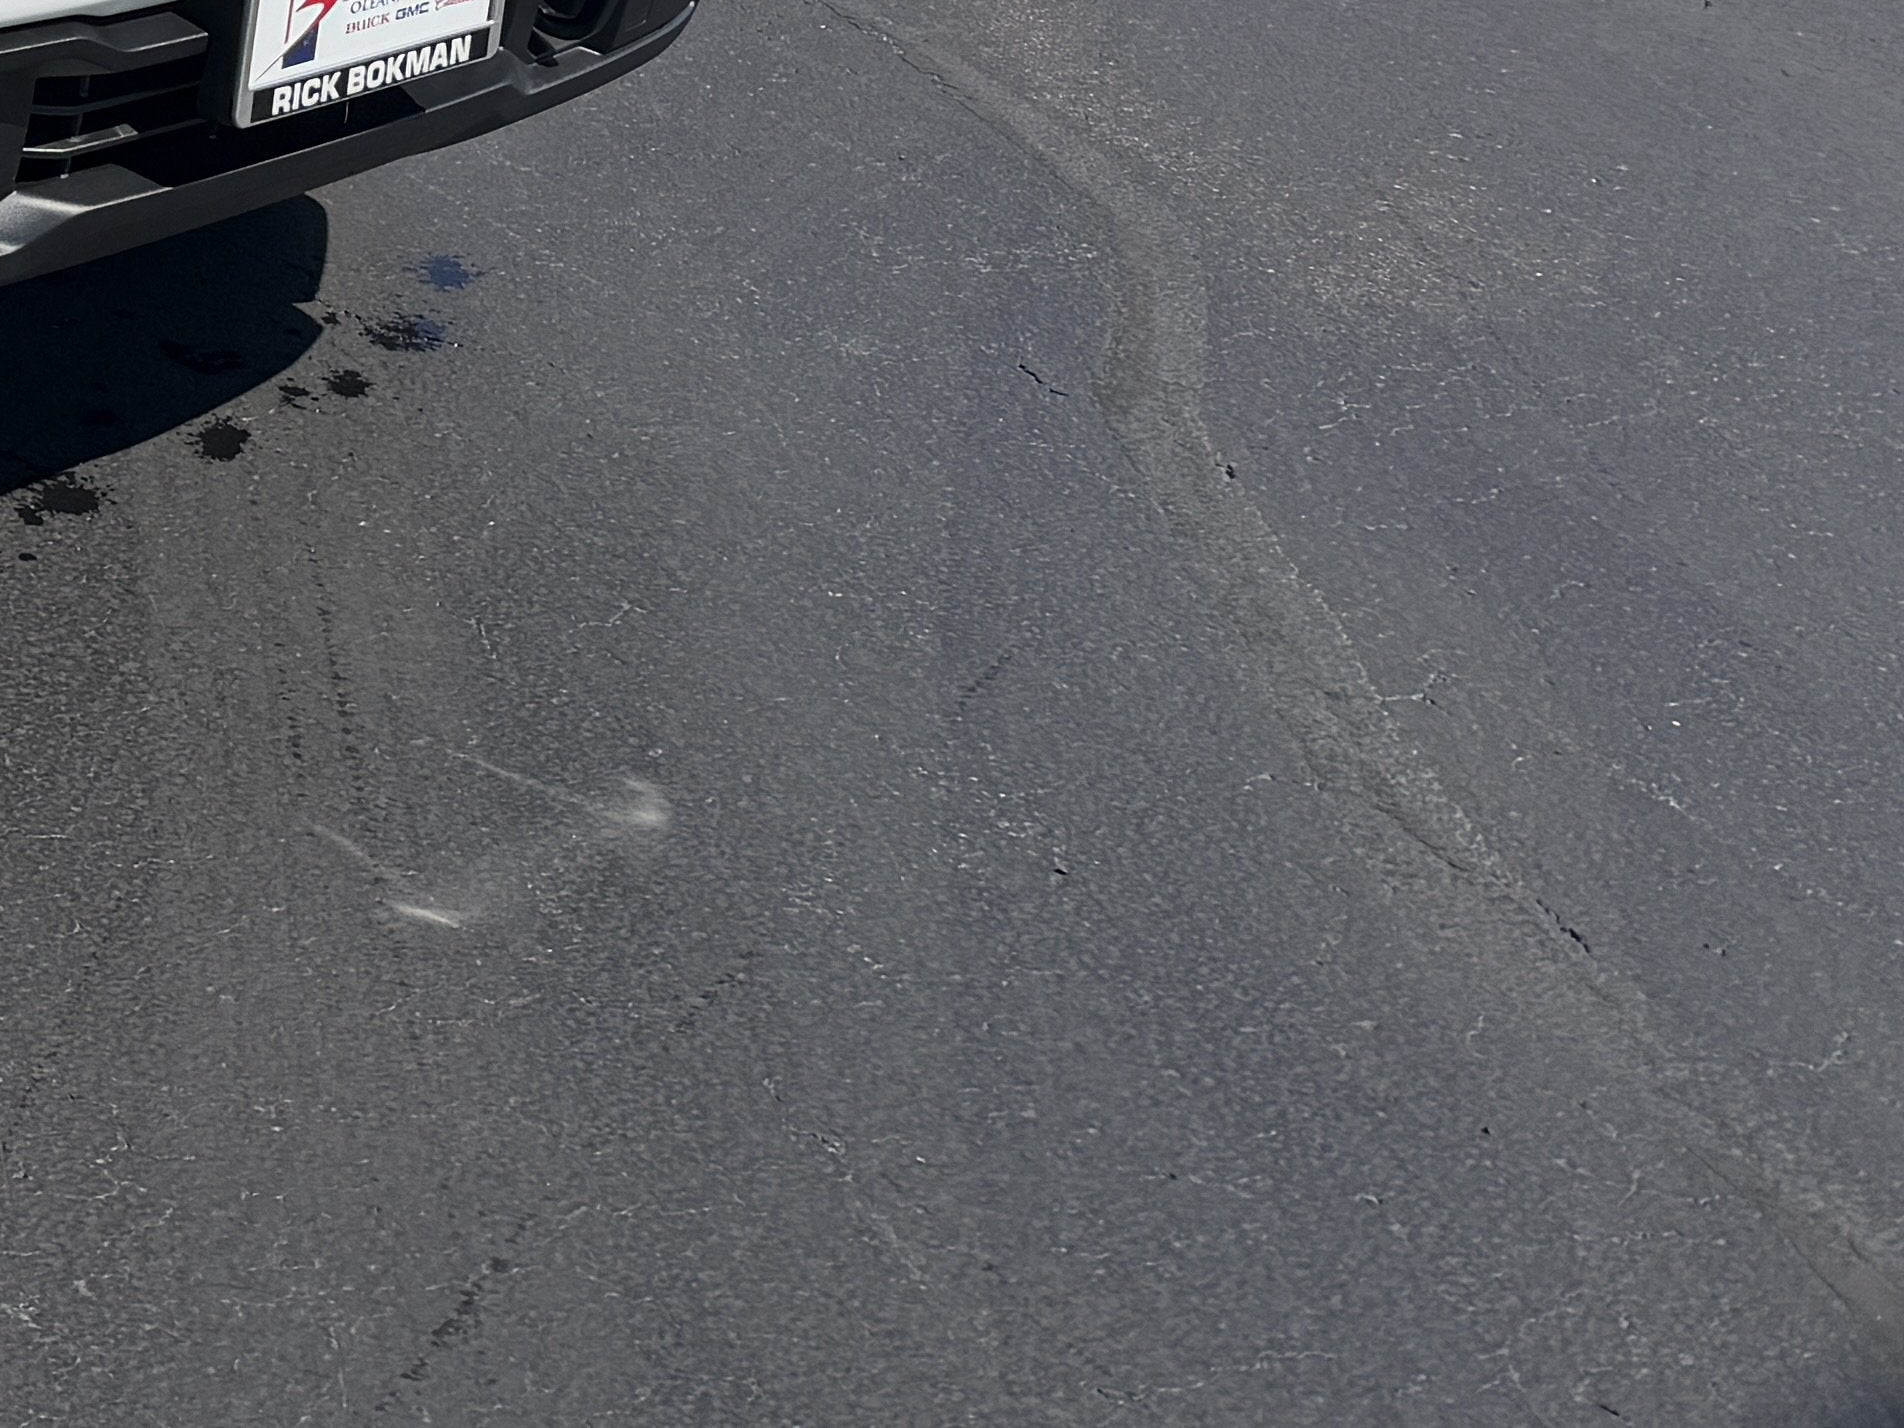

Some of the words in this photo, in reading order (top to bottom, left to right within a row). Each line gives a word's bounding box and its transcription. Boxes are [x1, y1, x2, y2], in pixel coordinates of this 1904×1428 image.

[345, 12, 390, 34] BUICK
[395, 1, 430, 20] GMC
[271, 71, 342, 116] RICK
[347, 34, 473, 96] BOKMAN
